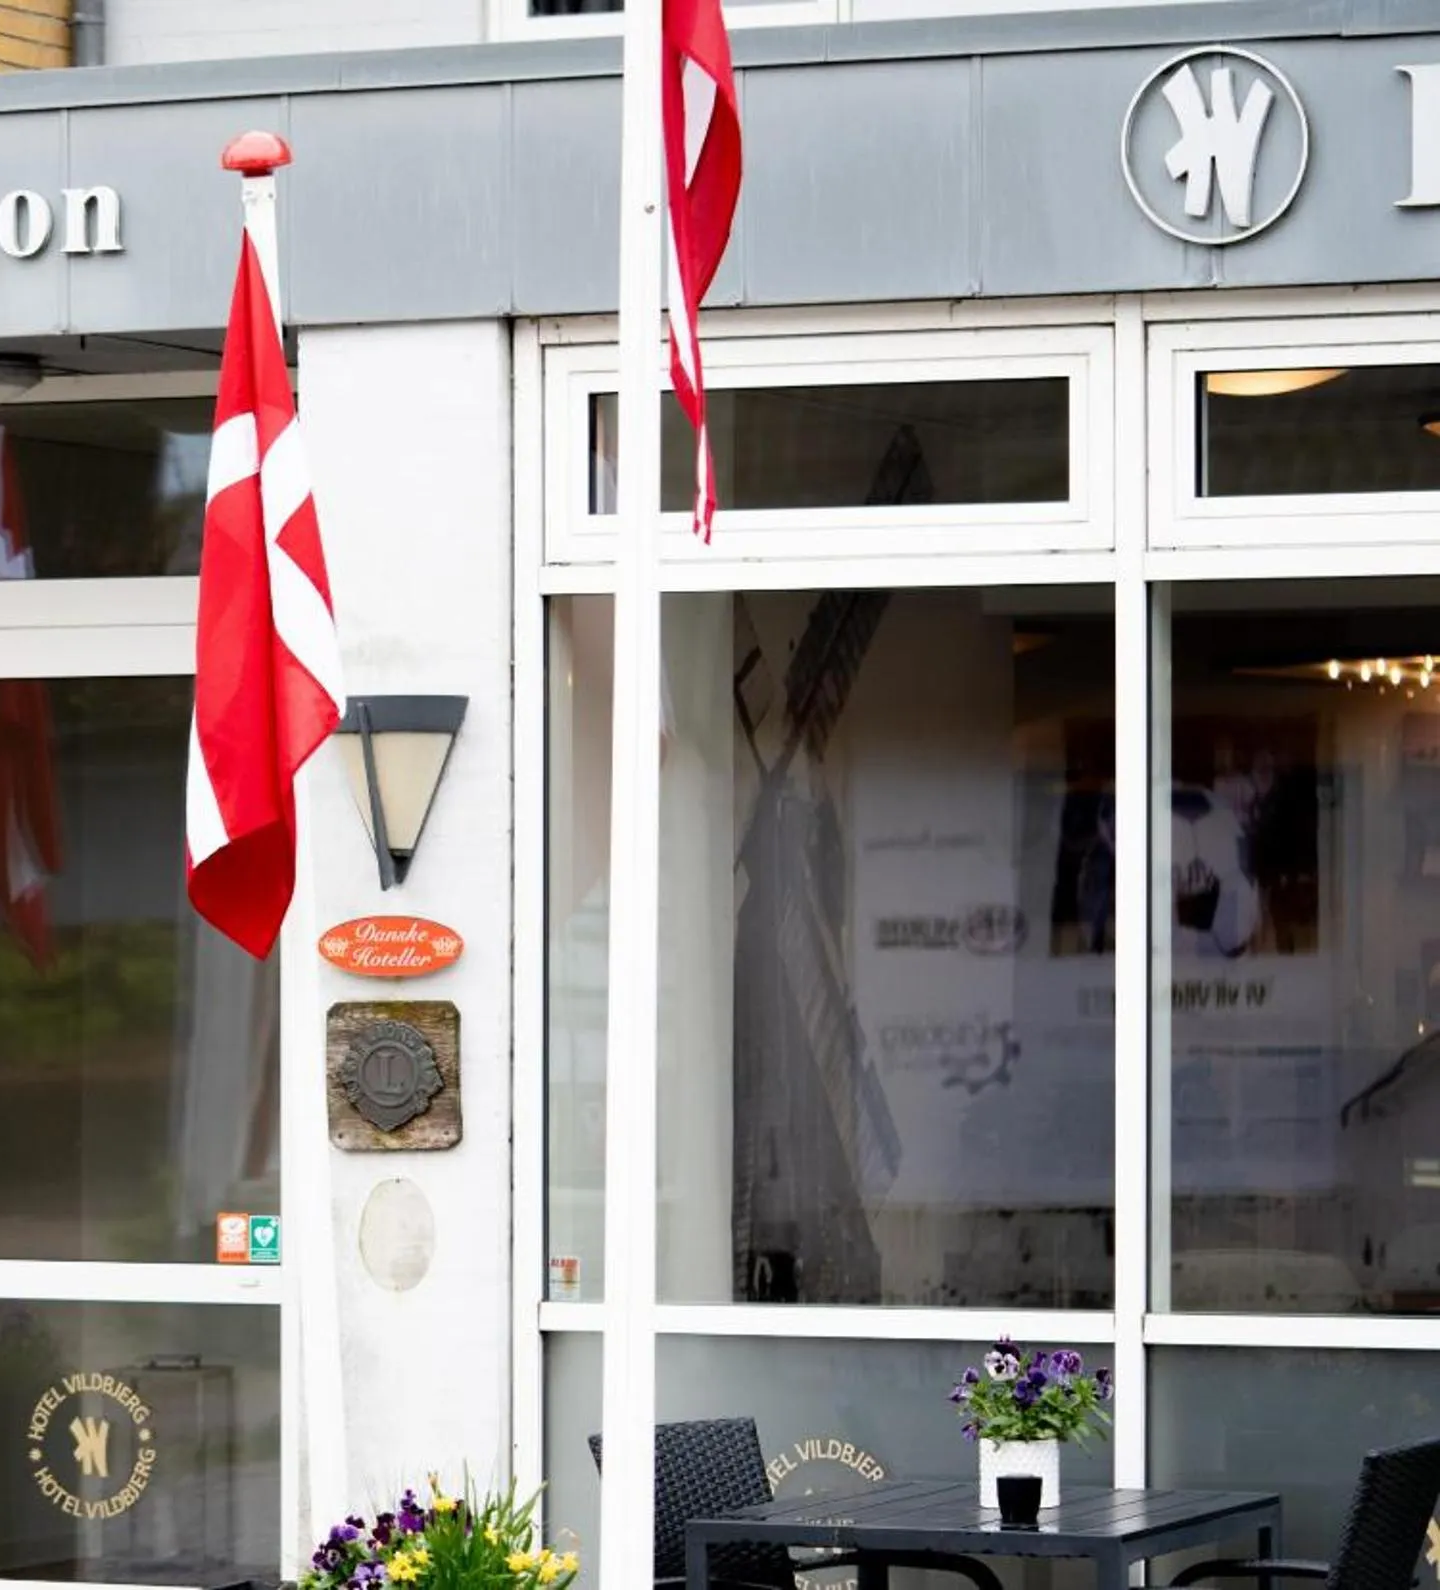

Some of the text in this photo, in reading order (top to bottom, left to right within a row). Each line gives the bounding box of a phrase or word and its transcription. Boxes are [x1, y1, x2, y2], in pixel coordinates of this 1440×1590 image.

[352, 947, 432, 968] Hoteller
[355, 921, 429, 943] Danske
[27, 1373, 151, 1441] HOTEL VILDBJERG
[34, 1448, 157, 1520] HOTEL VILDBJERG
[766, 1439, 885, 1495] TEL VILDBJER
